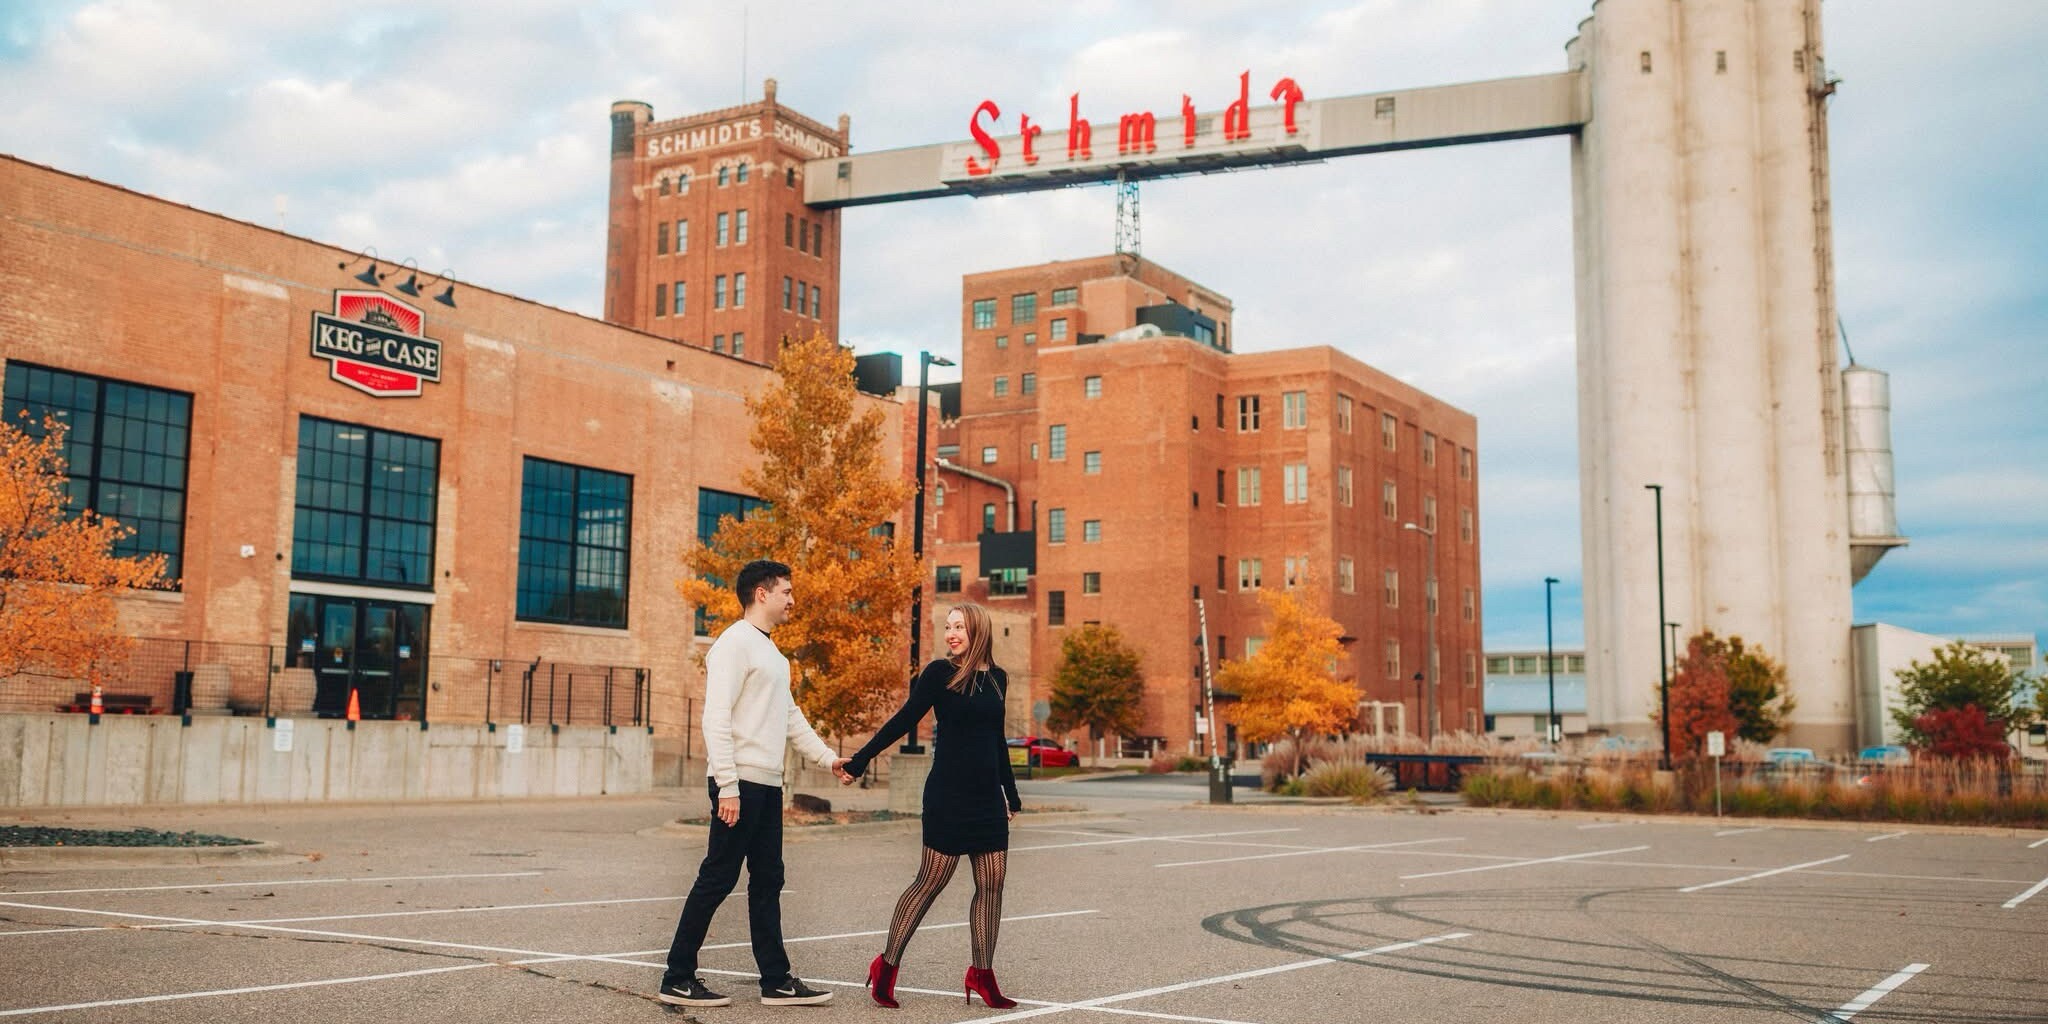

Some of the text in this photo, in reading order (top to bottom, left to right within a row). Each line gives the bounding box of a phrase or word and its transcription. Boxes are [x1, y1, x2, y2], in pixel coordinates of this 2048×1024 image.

[647, 118, 762, 157] SCHMIDT'S
[774, 119, 840, 158] SCHMIDT'S
[319, 322, 363, 355] KEG
[382, 338, 437, 371] CASE
